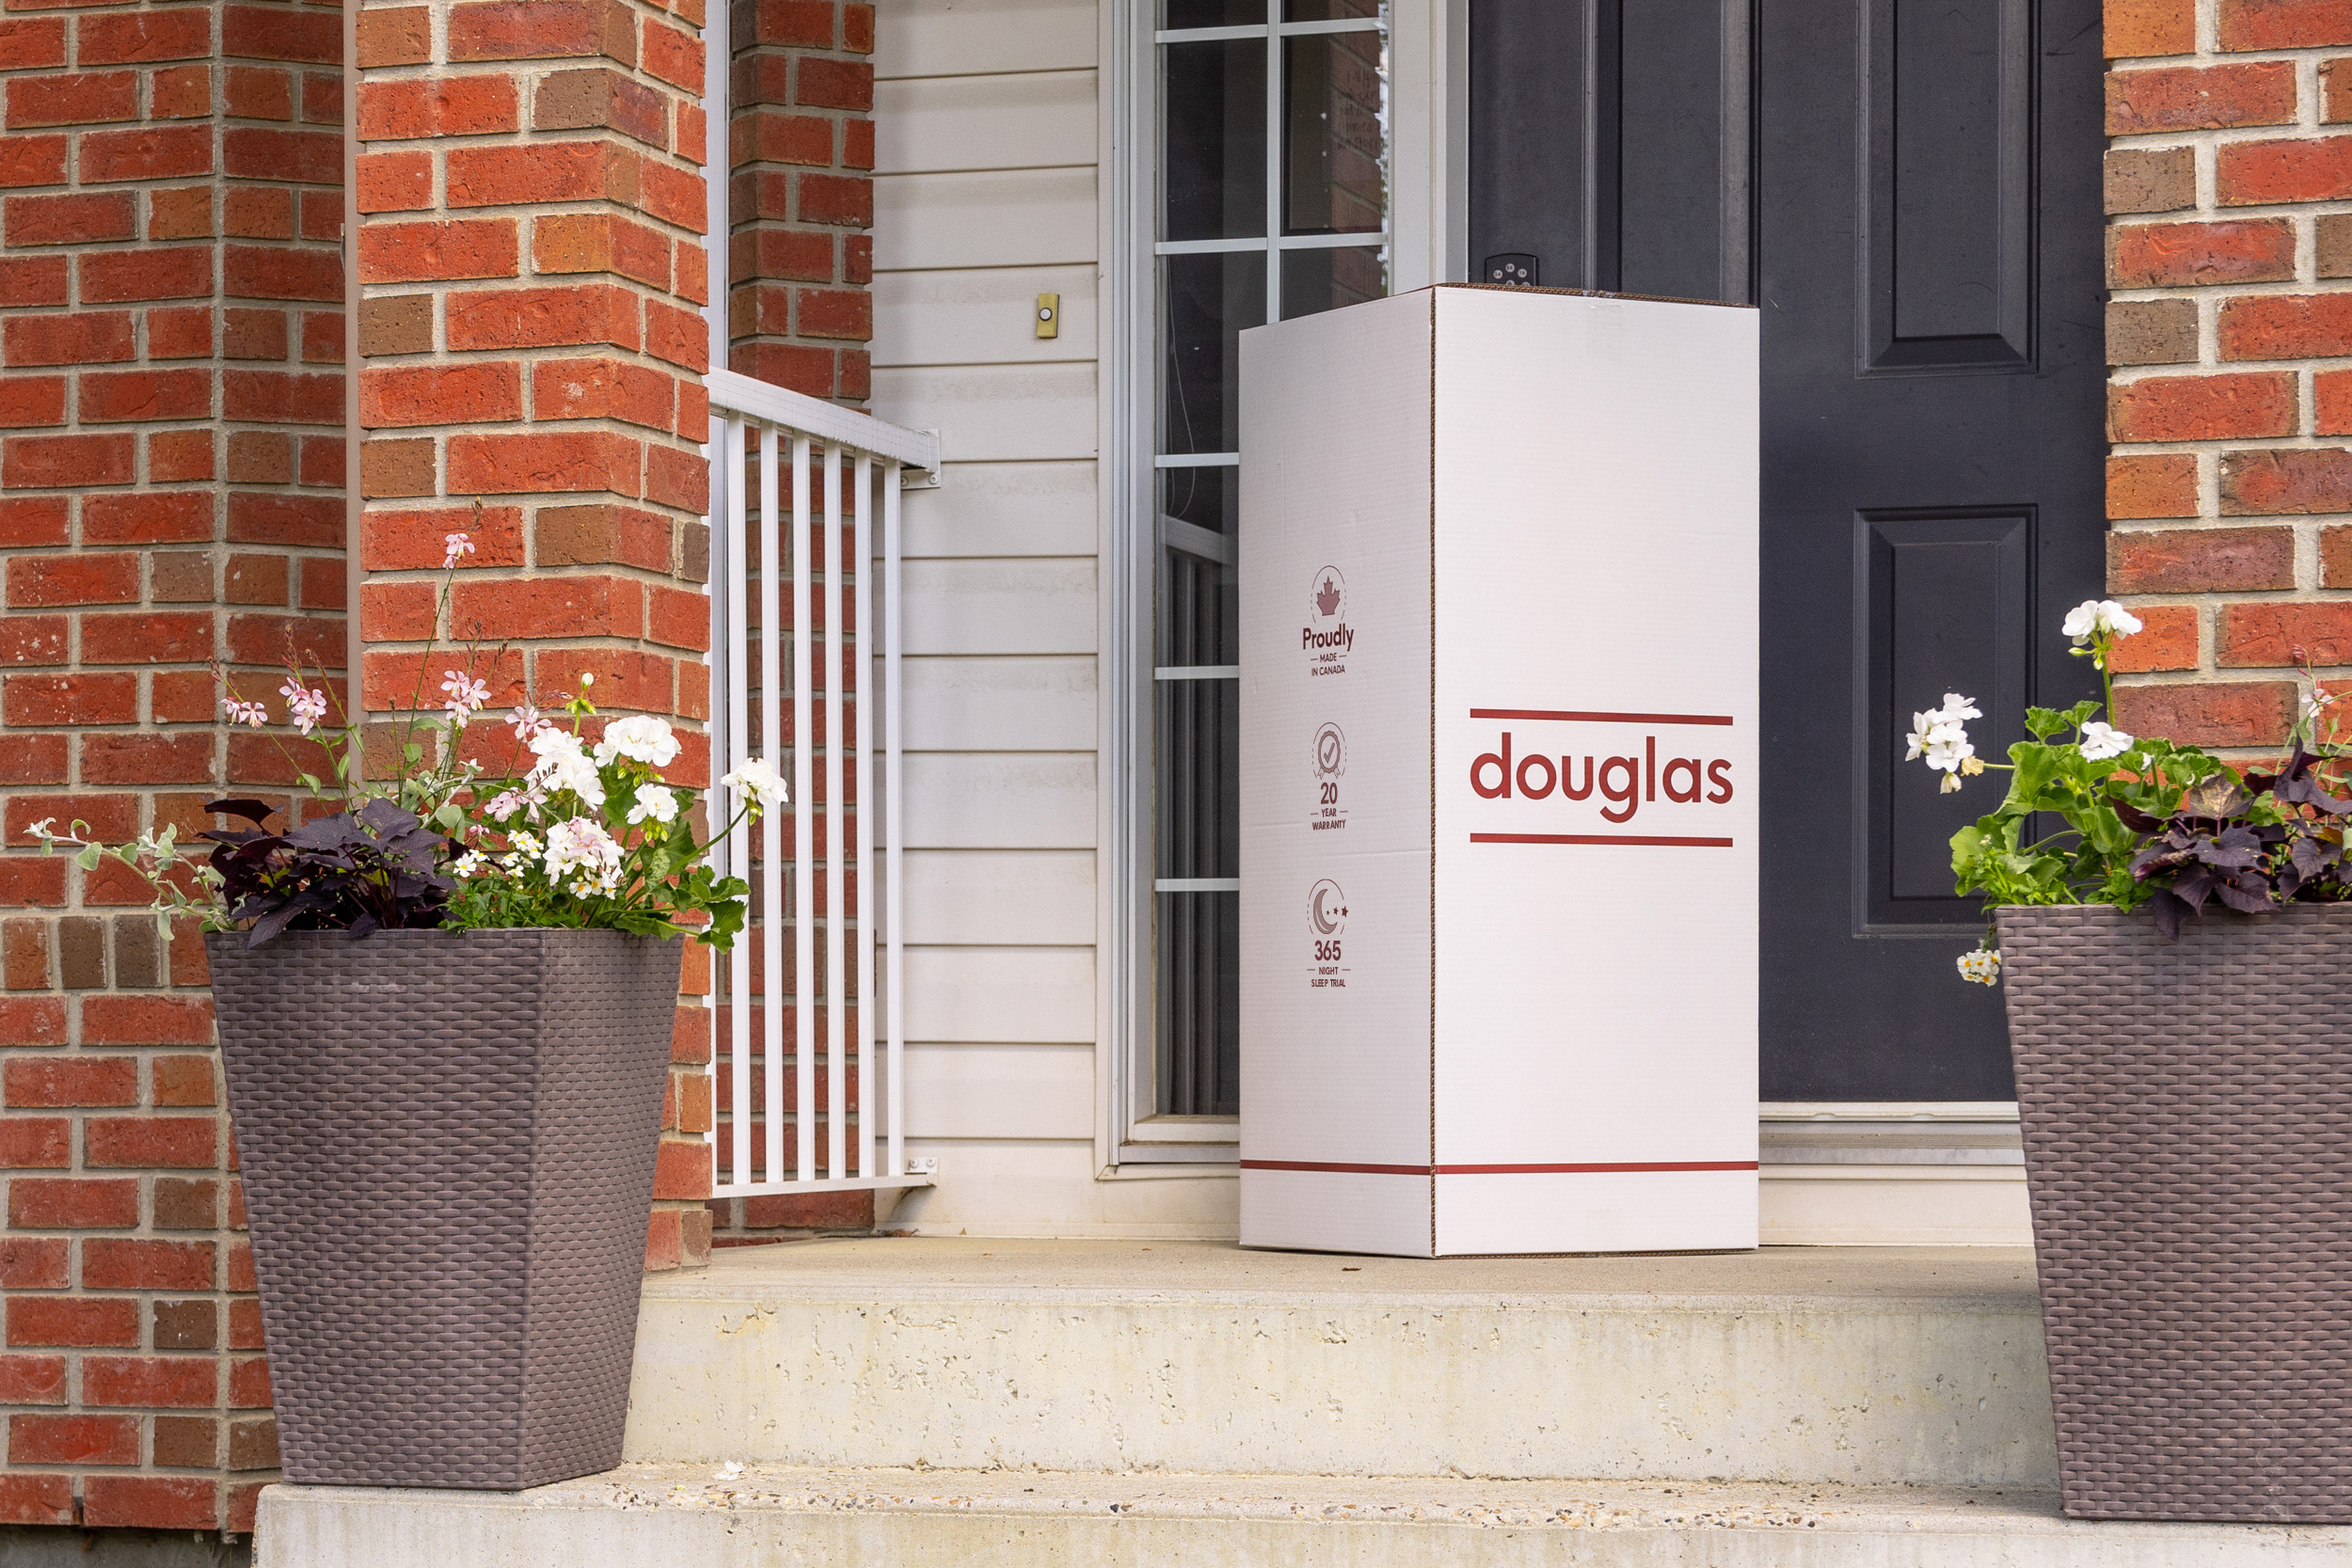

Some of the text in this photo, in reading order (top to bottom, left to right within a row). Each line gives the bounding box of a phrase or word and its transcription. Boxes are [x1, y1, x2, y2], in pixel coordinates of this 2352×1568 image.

[1303, 623, 1354, 652] Proudly
[1319, 653, 1337, 663] MADE
[1311, 665, 1345, 676] IN CANADA
[1470, 732, 1733, 823] douglas
[1320, 782, 1338, 804] 20
[1321, 808, 1337, 817] YEAR
[1311, 819, 1346, 831] WARRANTY
[1314, 940, 1342, 961] 365
[1318, 967, 1339, 975] NIGHT
[1311, 978, 1346, 988] SLEEP TRIAL
